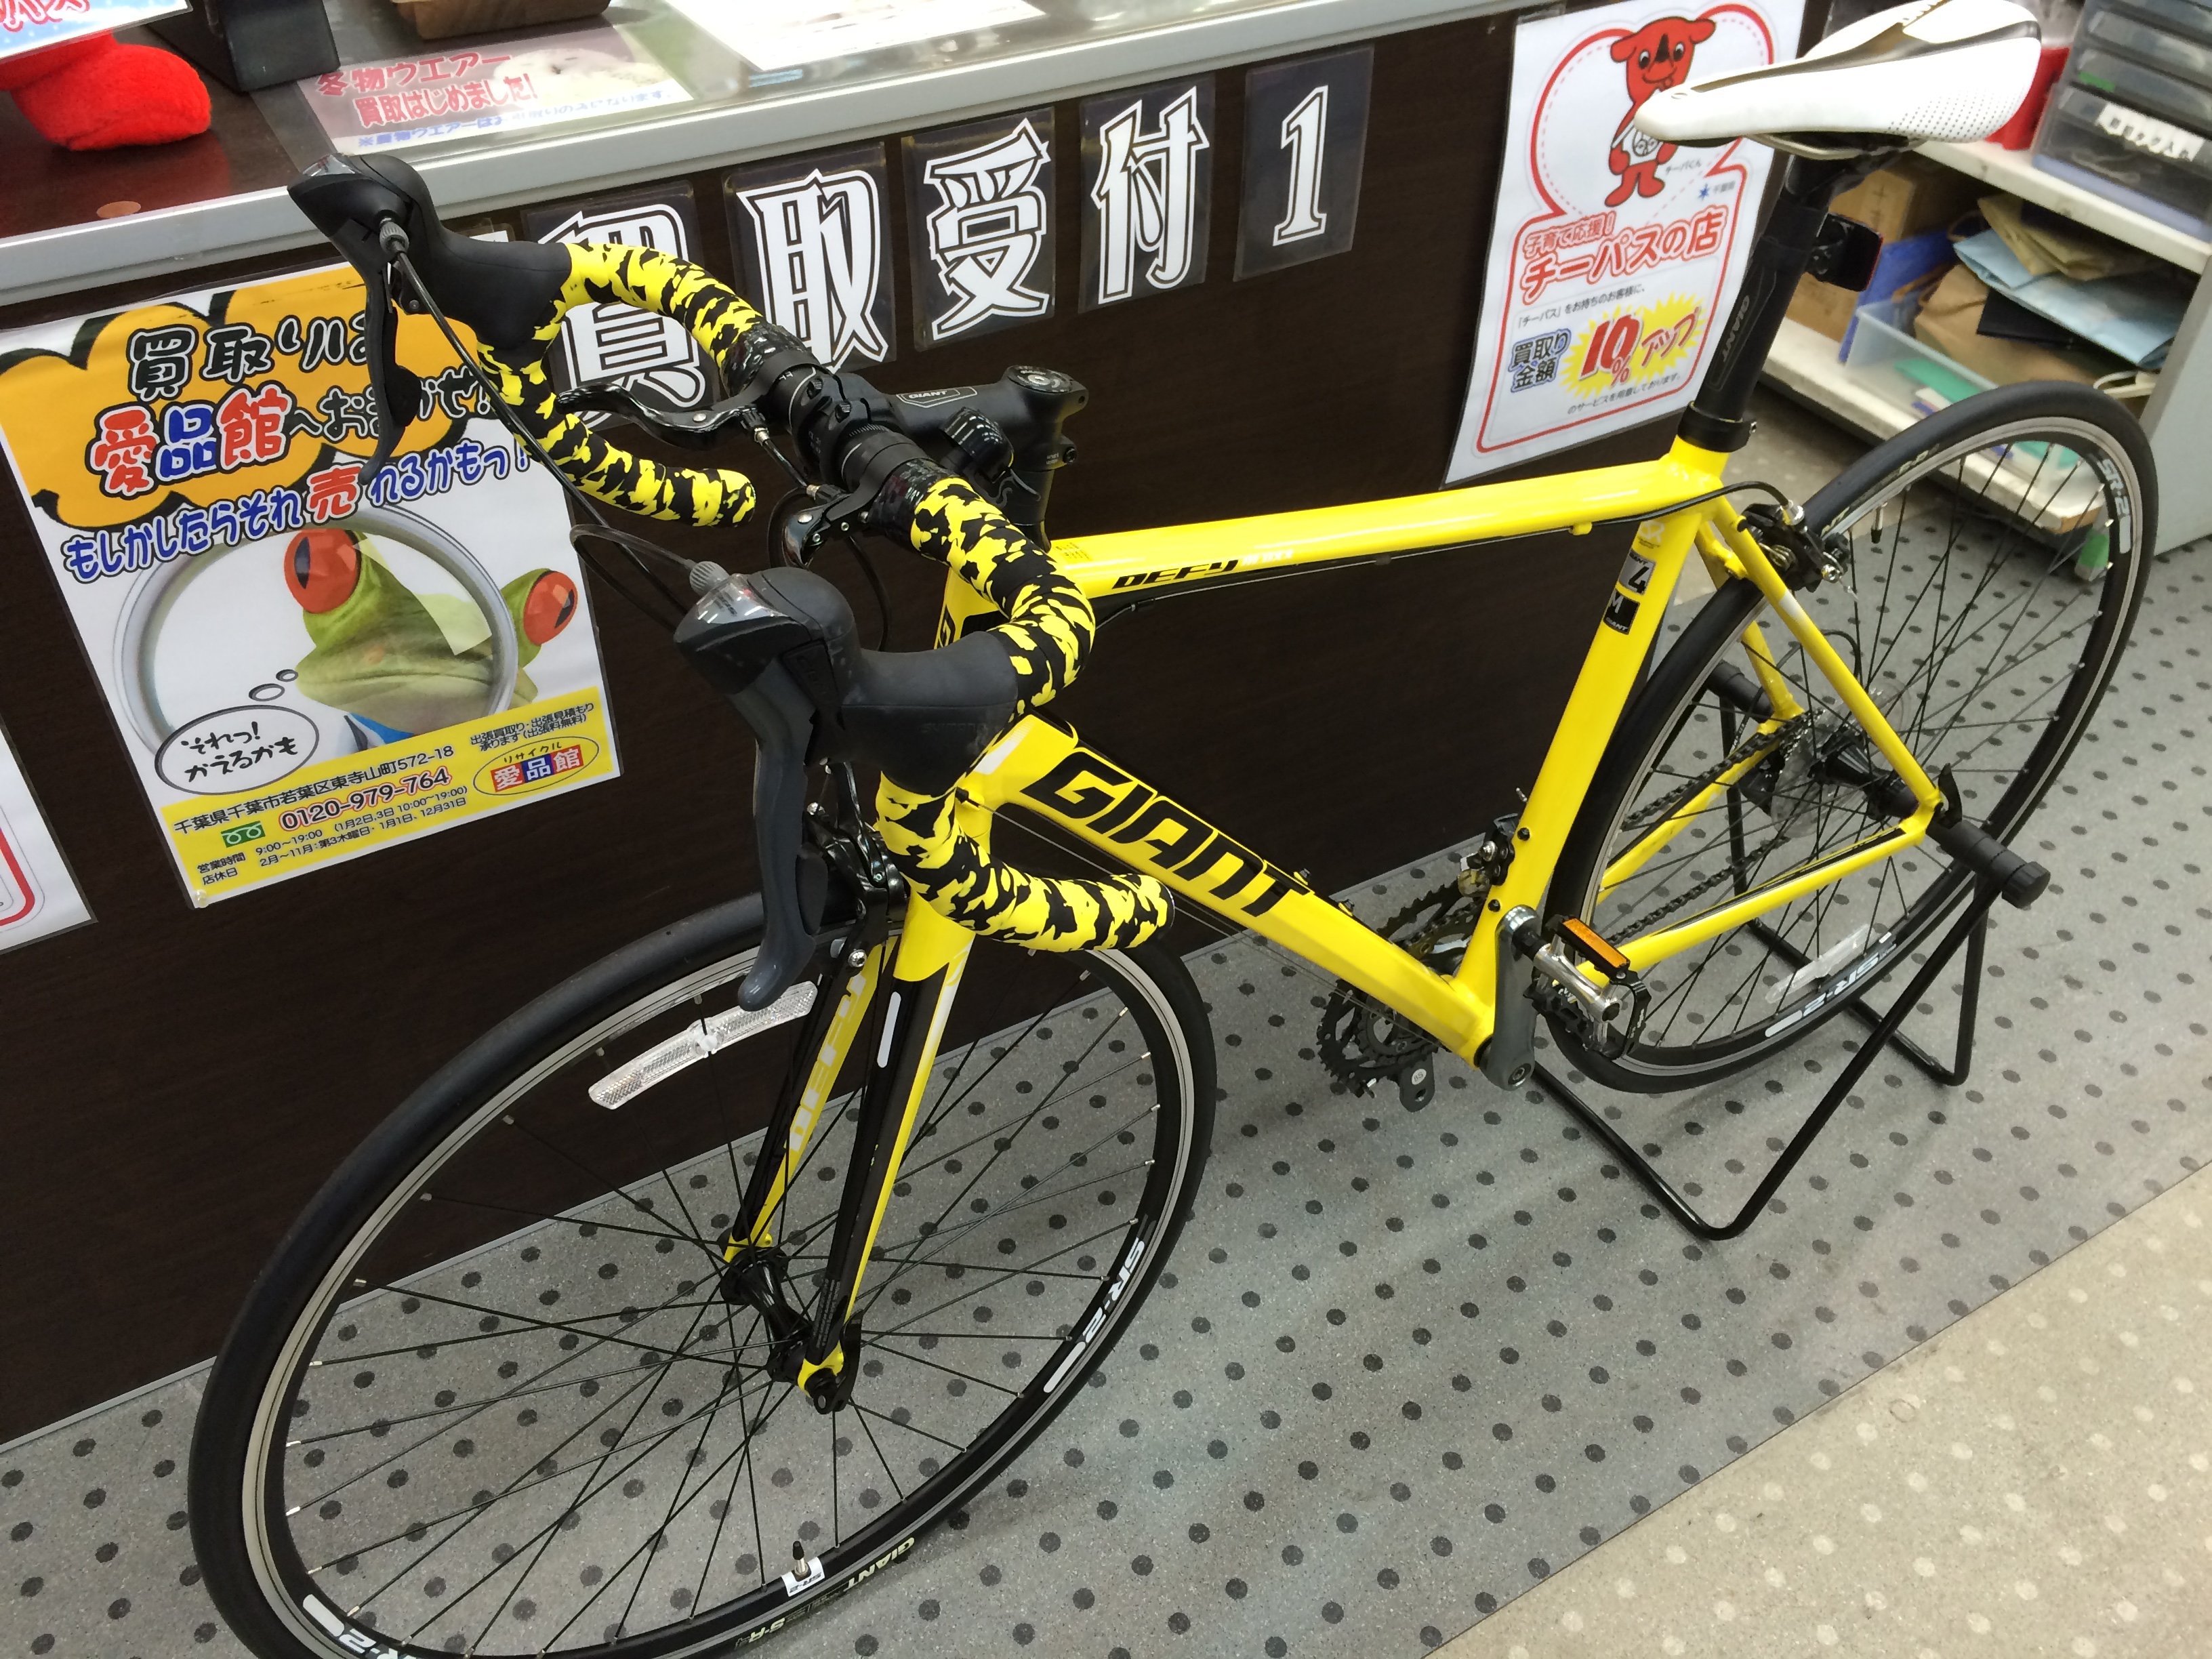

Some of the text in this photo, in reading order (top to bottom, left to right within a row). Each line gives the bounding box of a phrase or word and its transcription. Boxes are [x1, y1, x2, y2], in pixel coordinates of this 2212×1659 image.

[316, 52, 512, 97] 冬物ウエアー
[1521, 206, 1729, 305] チーパスの店
[1510, 329, 1570, 370] 買取り
[1641, 306, 1700, 367] アップ
[908, 390, 948, 400] GIANT
[1512, 356, 1559, 392] 金額
[1111, 559, 1240, 590] DEFY
[184, 736, 299, 783] かえるかも
[493, 747, 581, 791] 愛品館
[504, 741, 562, 764] リサイクル
[173, 745, 455, 834] 千葉県千葉市若葉区東寺山町572-18
[280, 766, 451, 831] 0120-979-764
[1020, 750, 1312, 918] GIANT
[197, 851, 246, 874] 営業時間
[202, 867, 239, 886] 店休日
[1082, 1236, 1145, 1344] SR-2
[843, 1537, 915, 1593] GIANT
